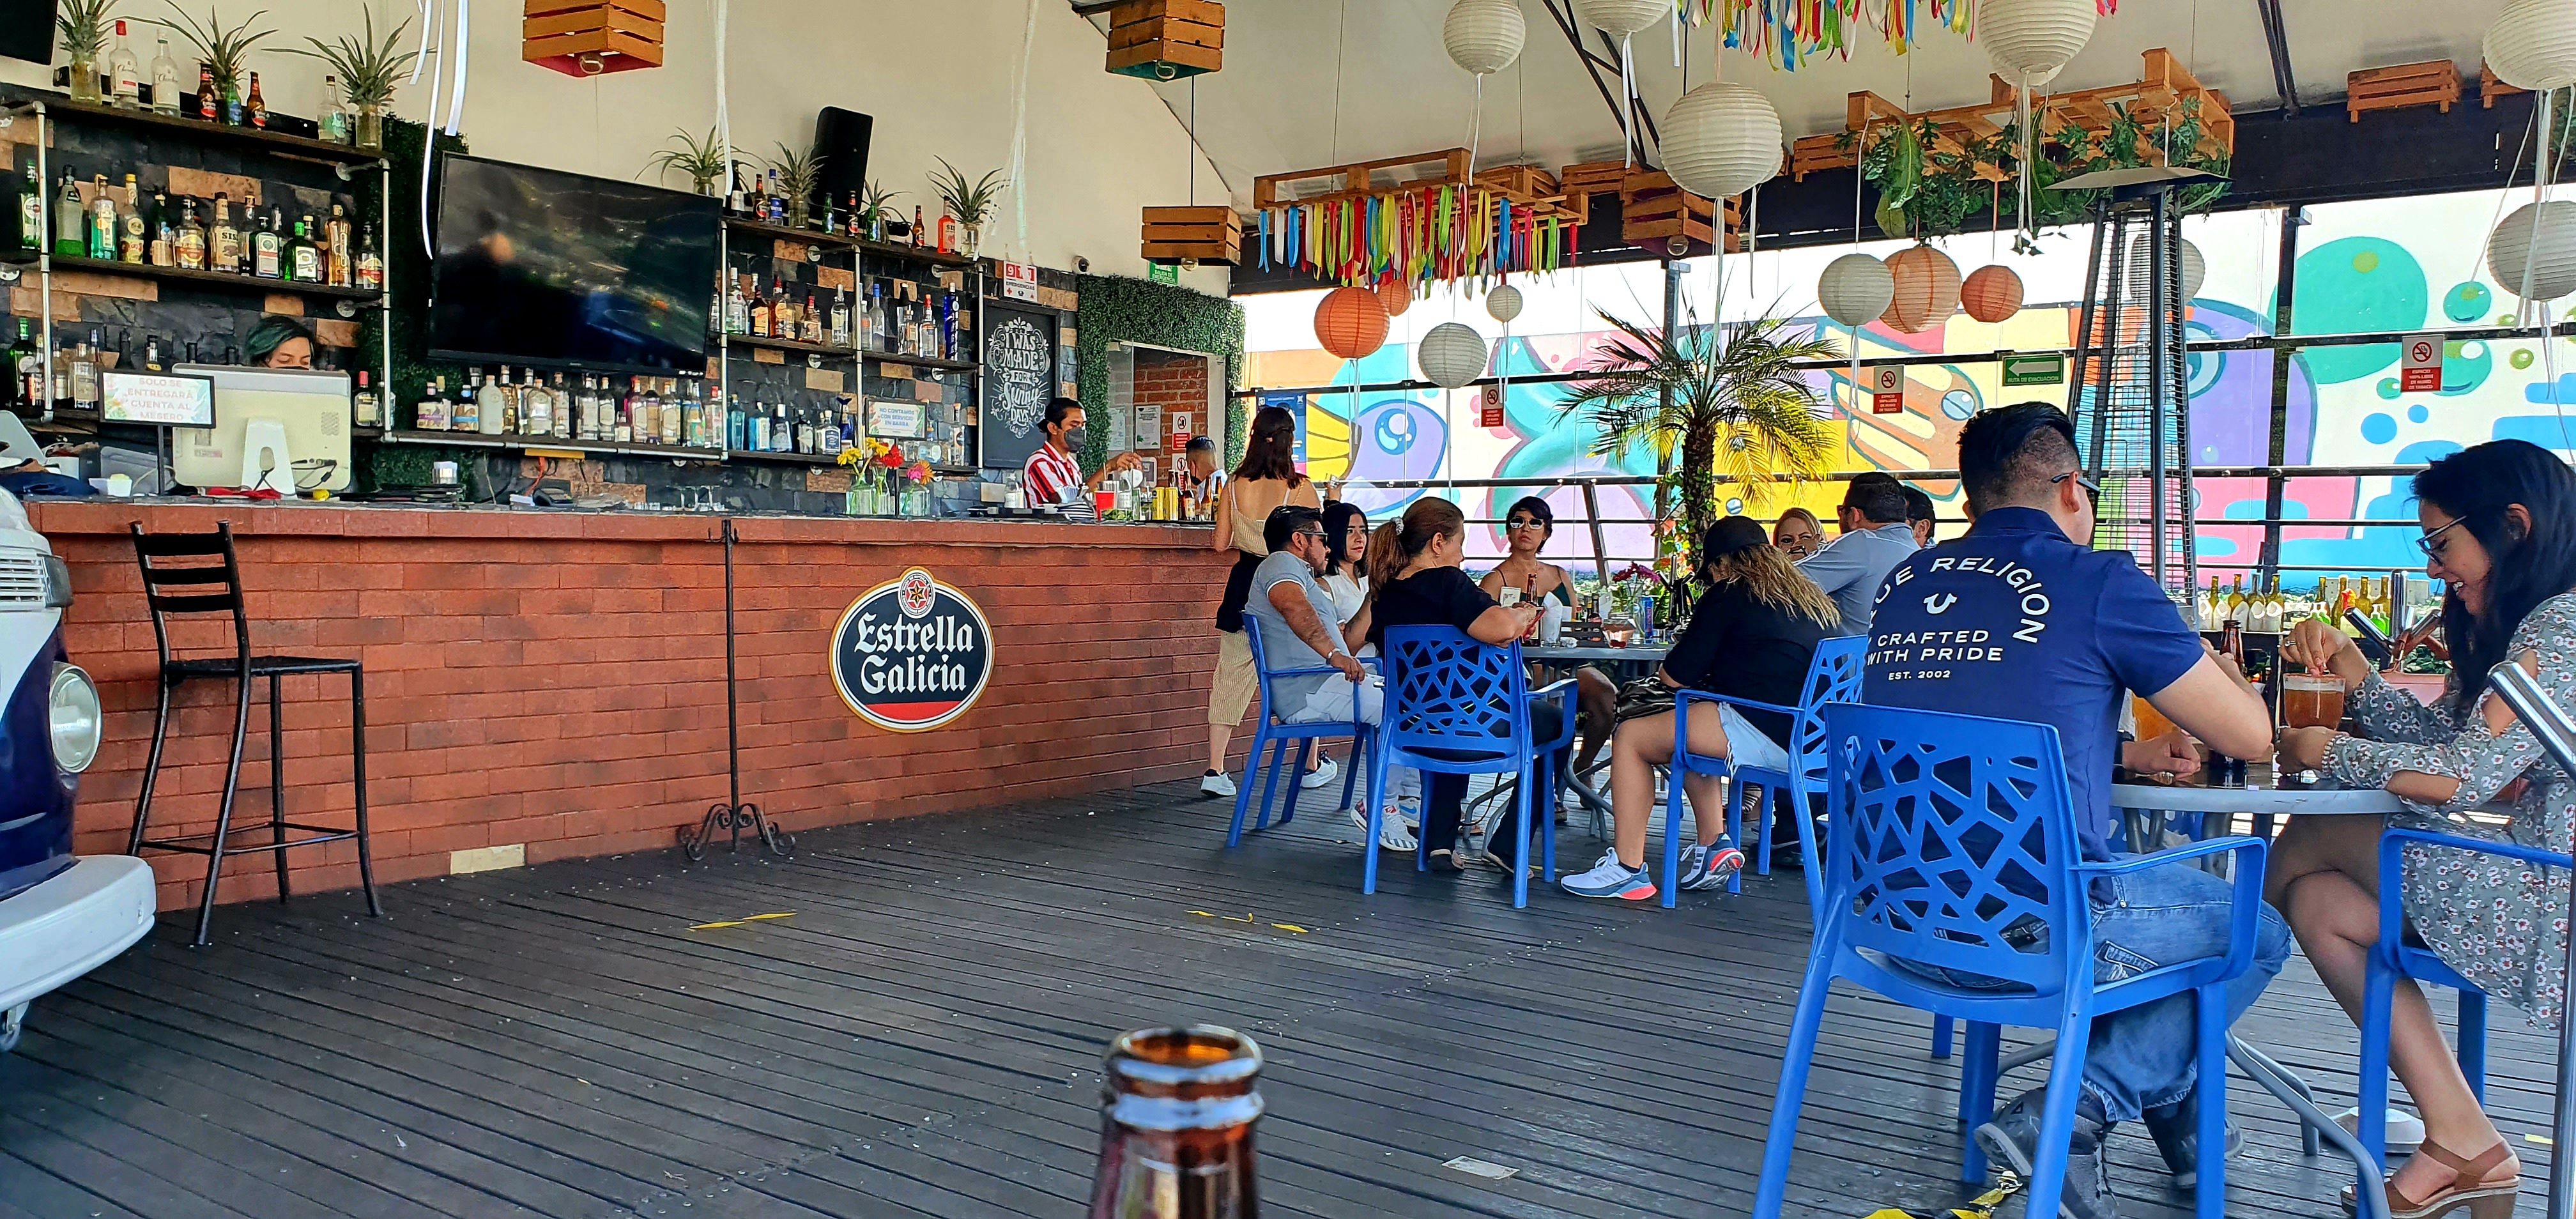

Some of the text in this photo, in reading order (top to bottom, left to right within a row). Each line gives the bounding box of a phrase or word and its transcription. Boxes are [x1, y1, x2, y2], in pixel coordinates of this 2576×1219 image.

[1007, 265, 1033, 282] 911
[1005, 330, 1036, 351] I WAS
[1001, 348, 1039, 371] MADE
[139, 378, 182, 387] SOLO SE
[1014, 371, 1028, 381] FOR
[131, 399, 174, 410] CUENTA
[999, 381, 1042, 416] Sunny
[140, 411, 184, 421] MESERO
[1010, 407, 1030, 423] DAYS
[1929, 557, 2050, 643] RELIGION
[854, 611, 974, 653] Estrella
[1877, 630, 1989, 647] CRAFTED
[1867, 647, 2004, 666] WITH PRIDE
[861, 654, 967, 694] Galicia
[1888, 670, 1951, 680] EST. 2002
